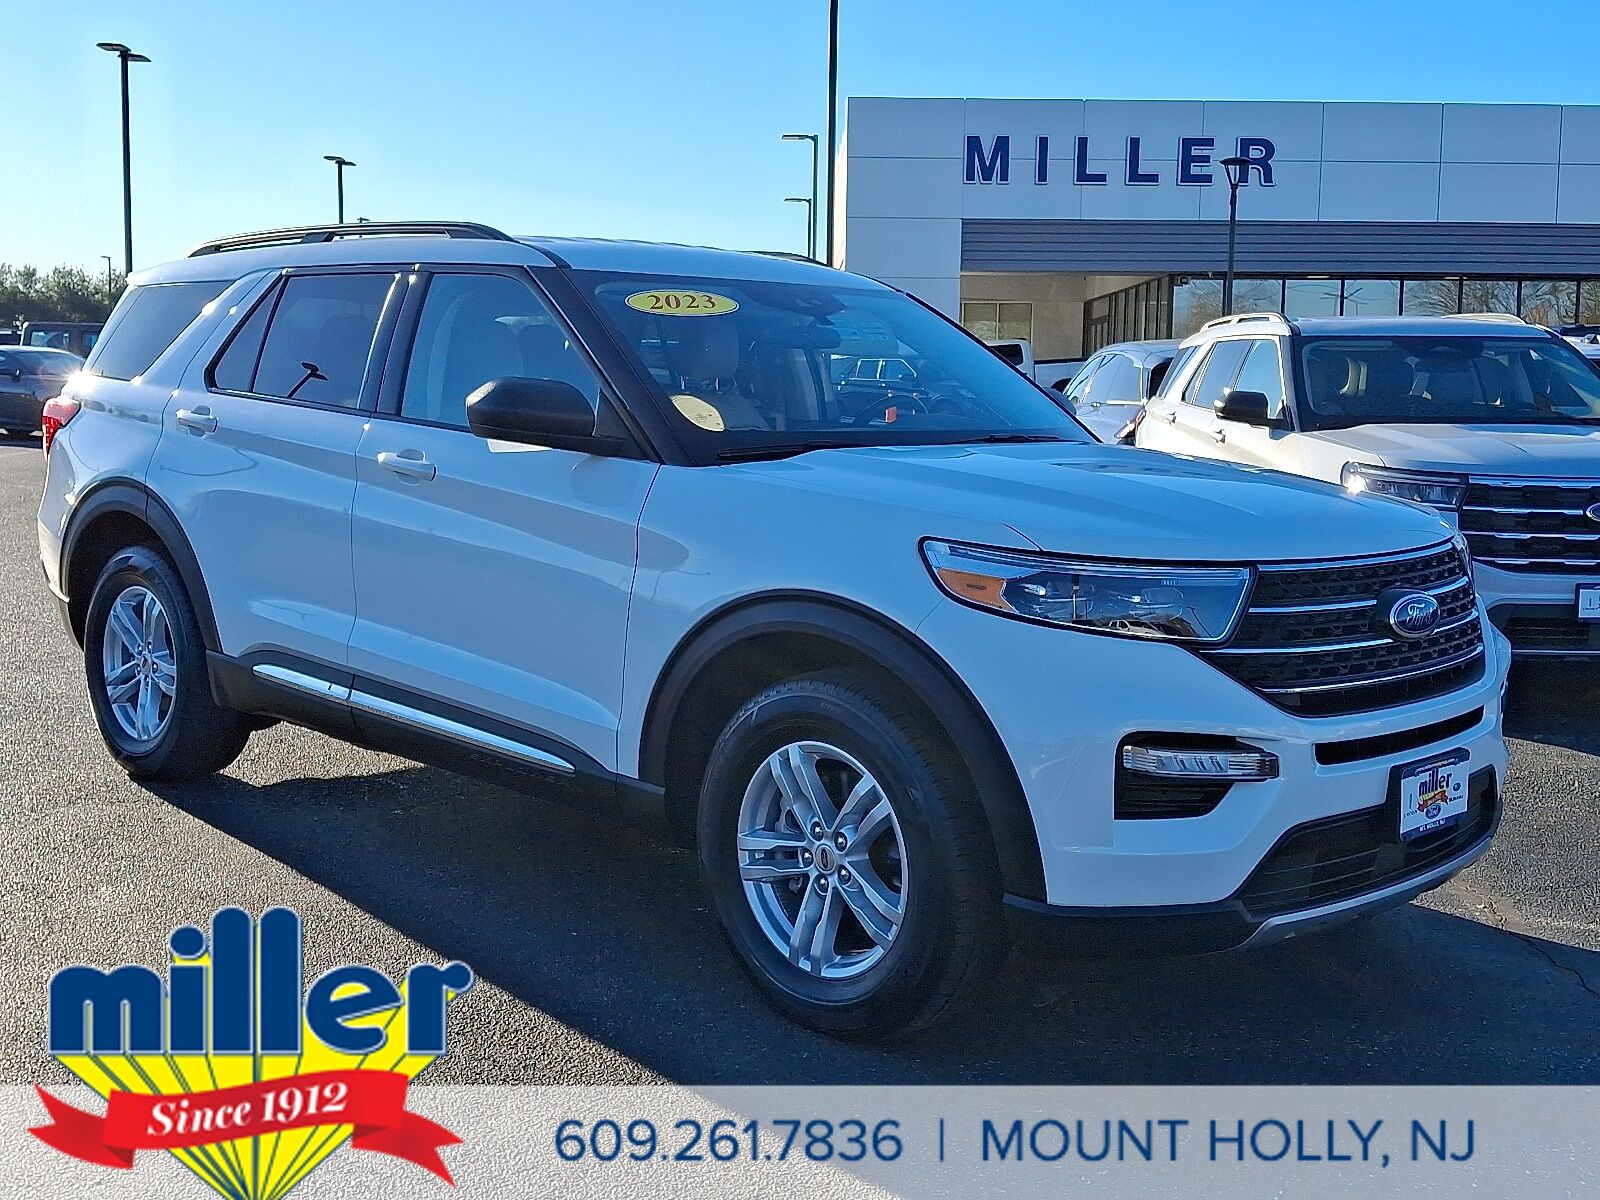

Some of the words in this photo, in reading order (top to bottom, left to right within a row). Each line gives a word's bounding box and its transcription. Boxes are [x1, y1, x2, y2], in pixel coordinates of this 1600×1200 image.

[963, 135, 1276, 187] MILLER
[646, 294, 716, 310] 2023
[1406, 603, 1433, 625] Ford
[1418, 767, 1452, 798] miller
